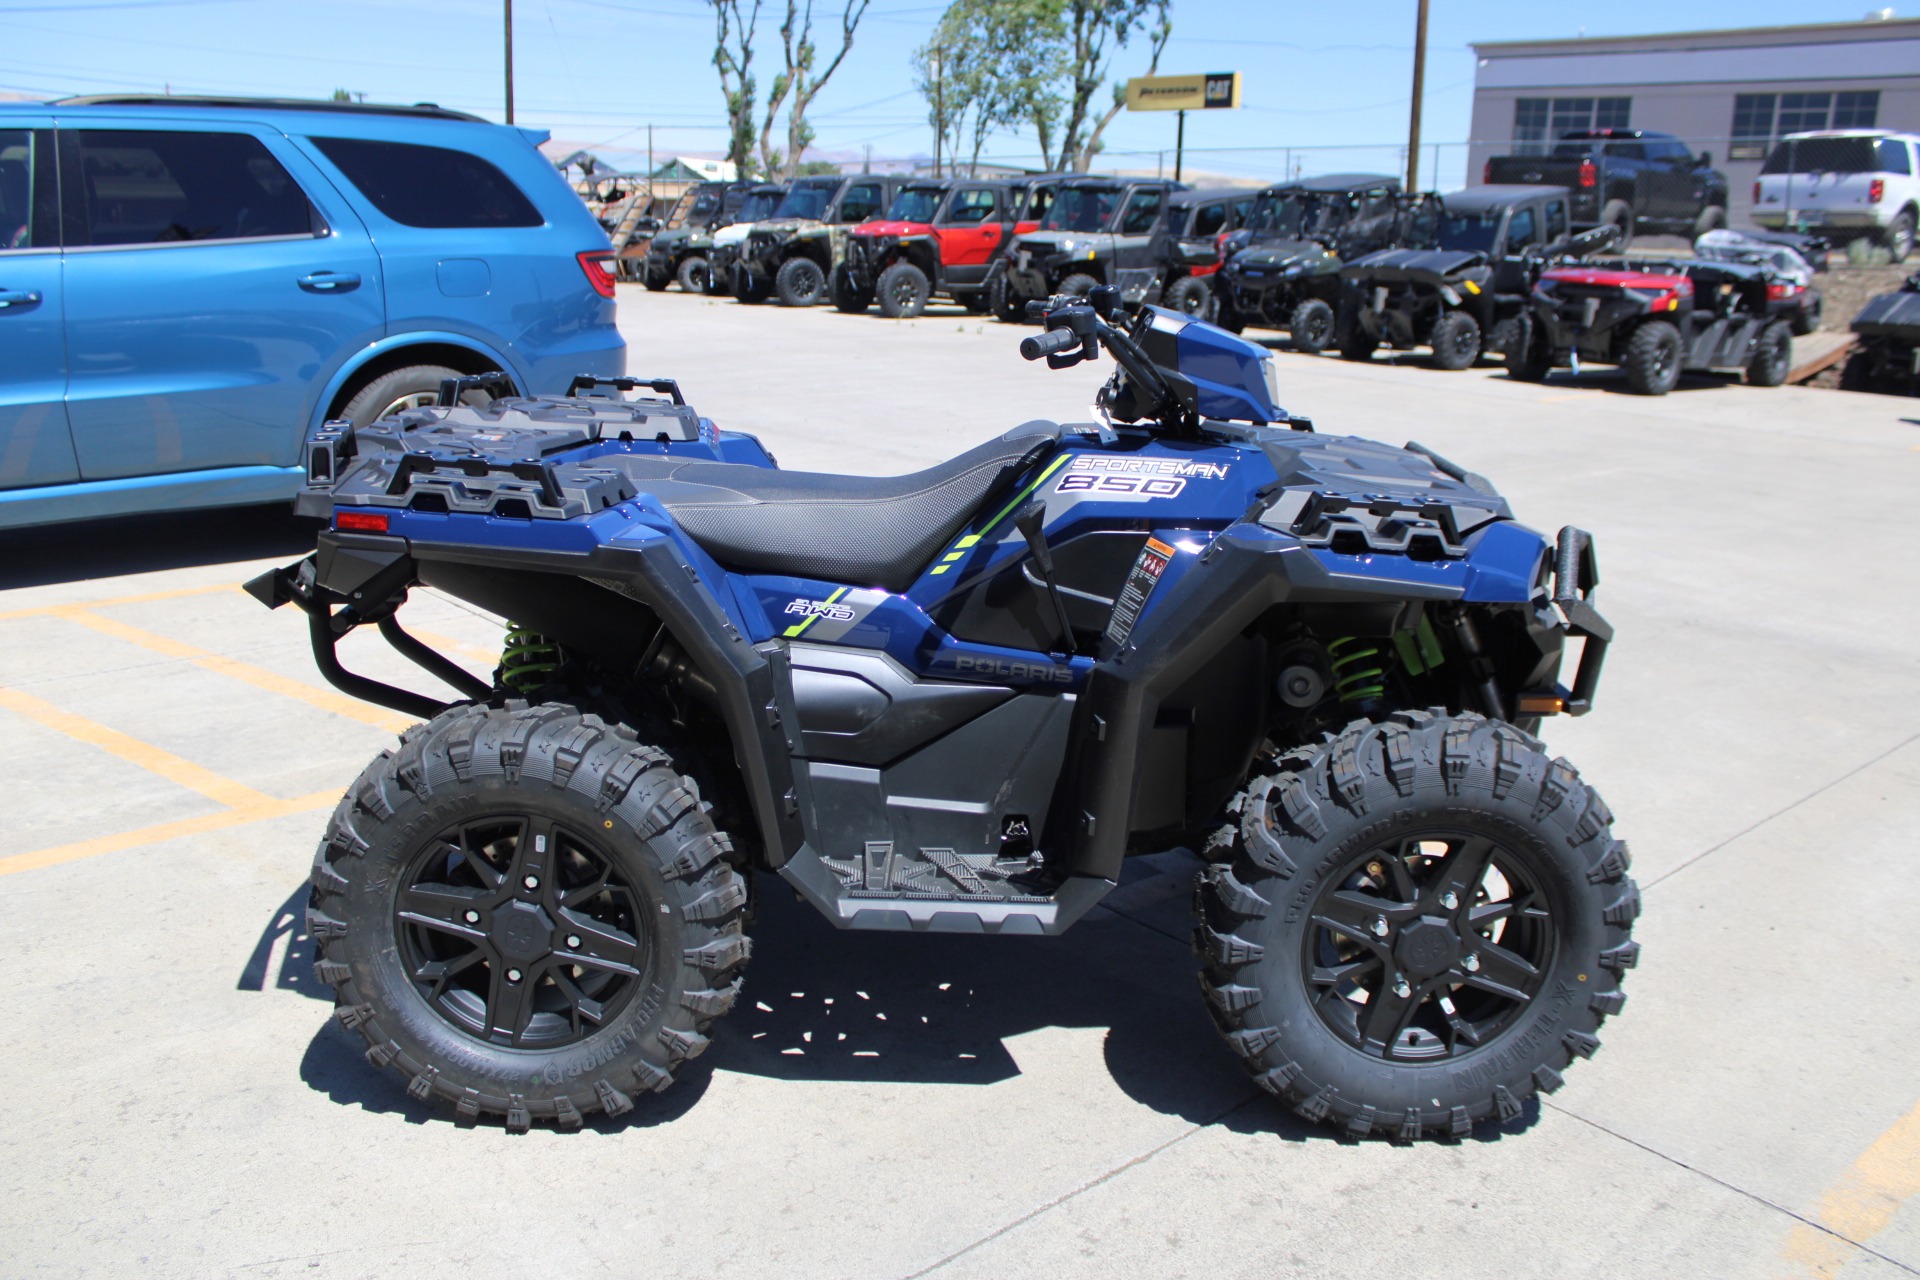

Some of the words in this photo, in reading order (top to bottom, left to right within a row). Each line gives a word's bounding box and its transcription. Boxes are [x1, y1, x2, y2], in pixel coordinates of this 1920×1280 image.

[1206, 80, 1231, 99] CAT
[1071, 457, 1231, 480] SPORTSMAN
[1055, 472, 1187, 499] 850
[784, 602, 856, 621] AWD
[956, 655, 1073, 683] POLARIS
[565, 1023, 637, 1077] ARMOR
